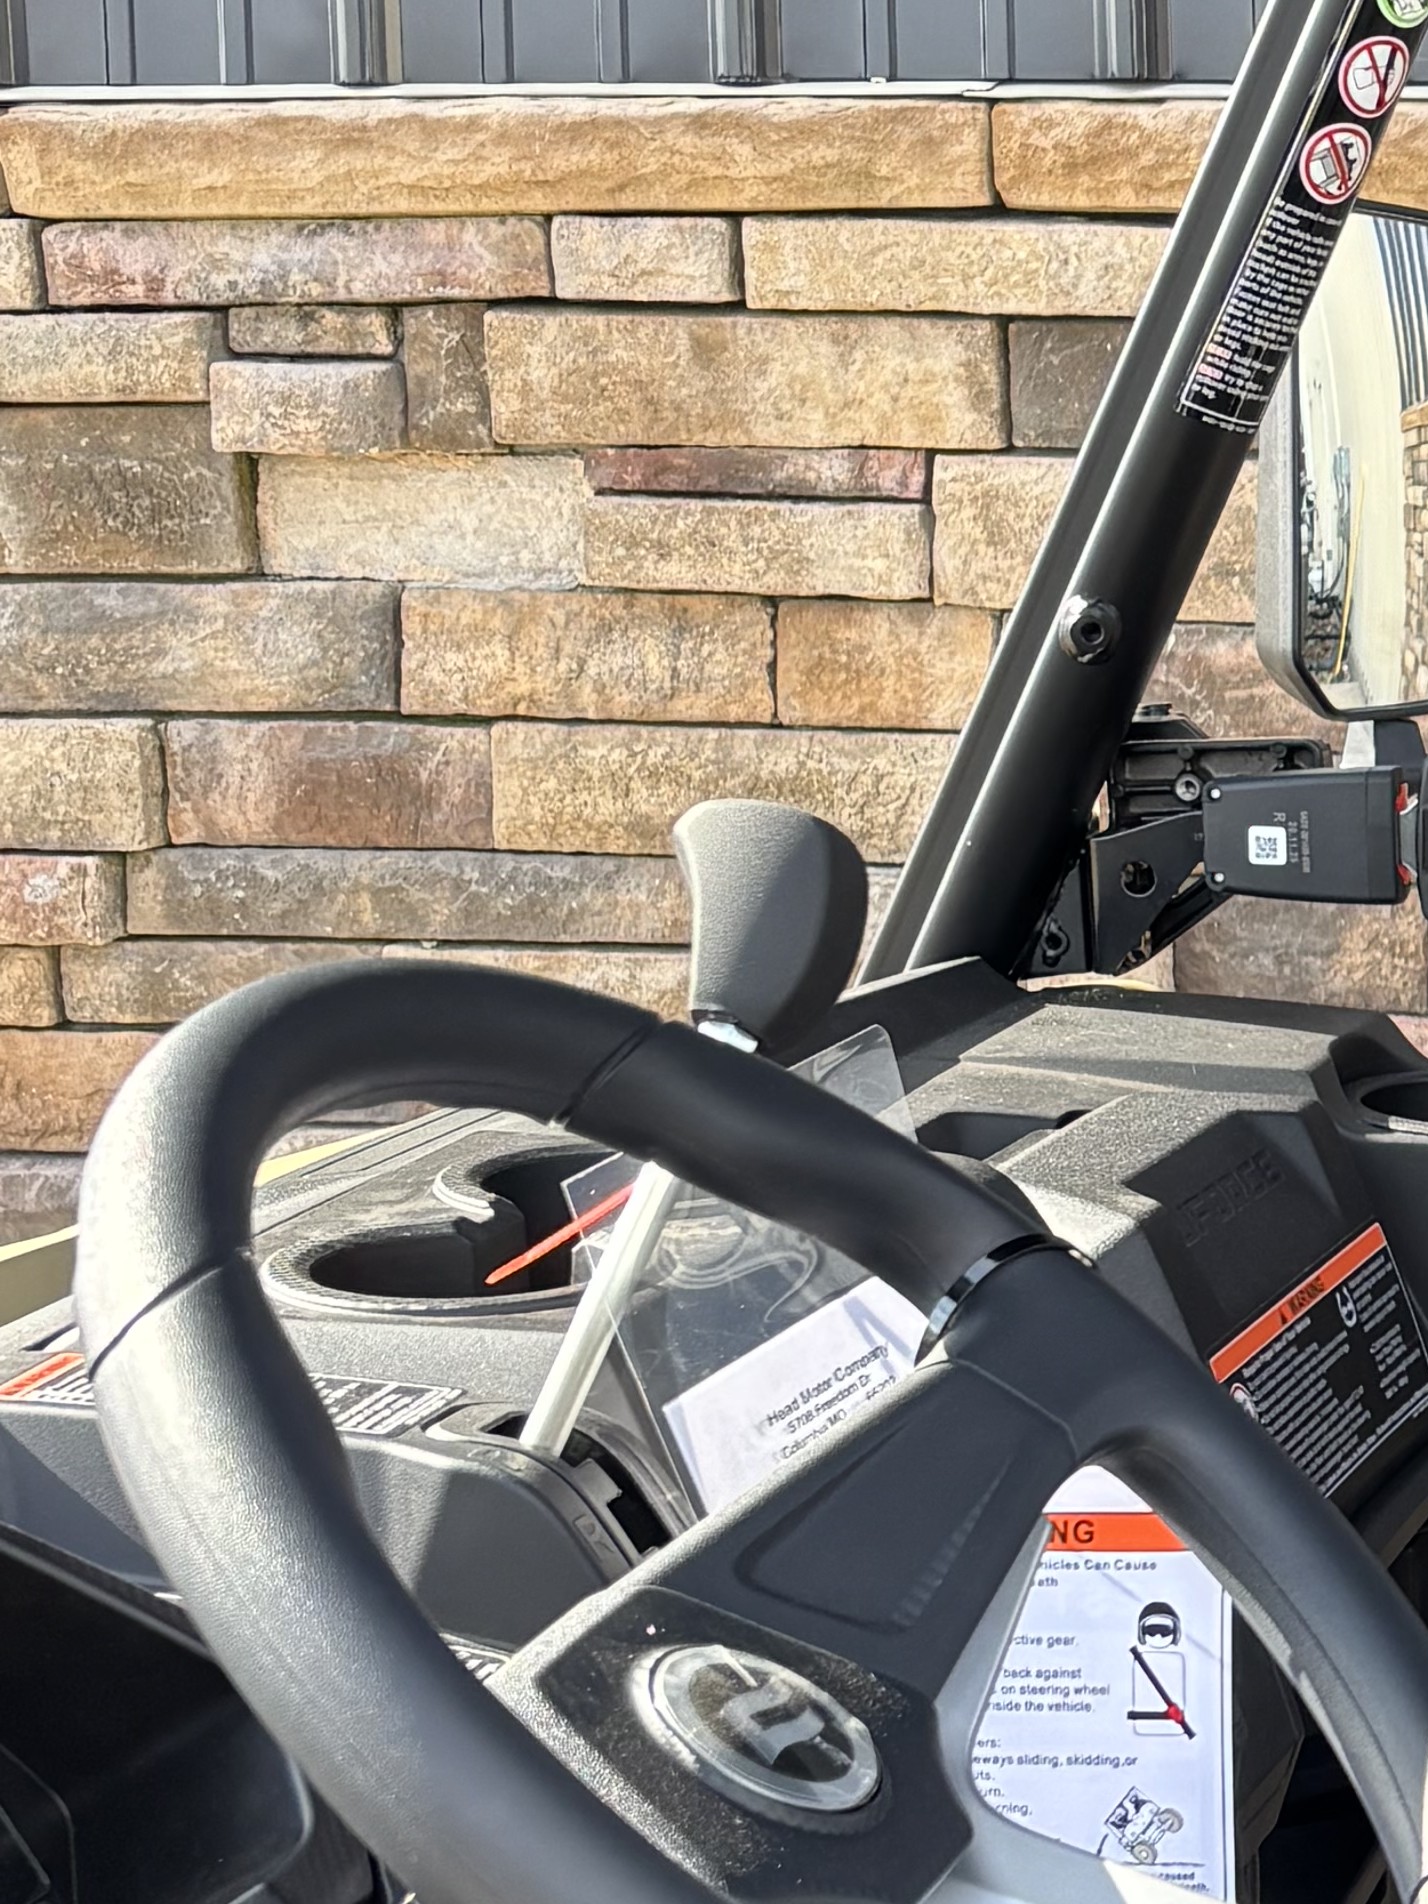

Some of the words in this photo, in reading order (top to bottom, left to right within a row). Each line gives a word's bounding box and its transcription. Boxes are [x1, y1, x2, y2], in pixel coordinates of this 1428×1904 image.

[1273, 812, 1286, 822] R
[766, 1399, 800, 1426] Head
[799, 1377, 834, 1405] Motor
[833, 1342, 889, 1382] Company
[1083, 1559, 1111, 1571] Can
[1114, 1559, 1157, 1571] Cause
[1013, 1635, 1043, 1646] ctive
[1035, 1667, 1082, 1681] against
[1001, 1685, 1017, 1695] on
[1019, 1684, 1070, 1699] steering
[1073, 1684, 1111, 1696] wheel
[1024, 1700, 1044, 1712] the
[1017, 1754, 1063, 1769] sliding,
